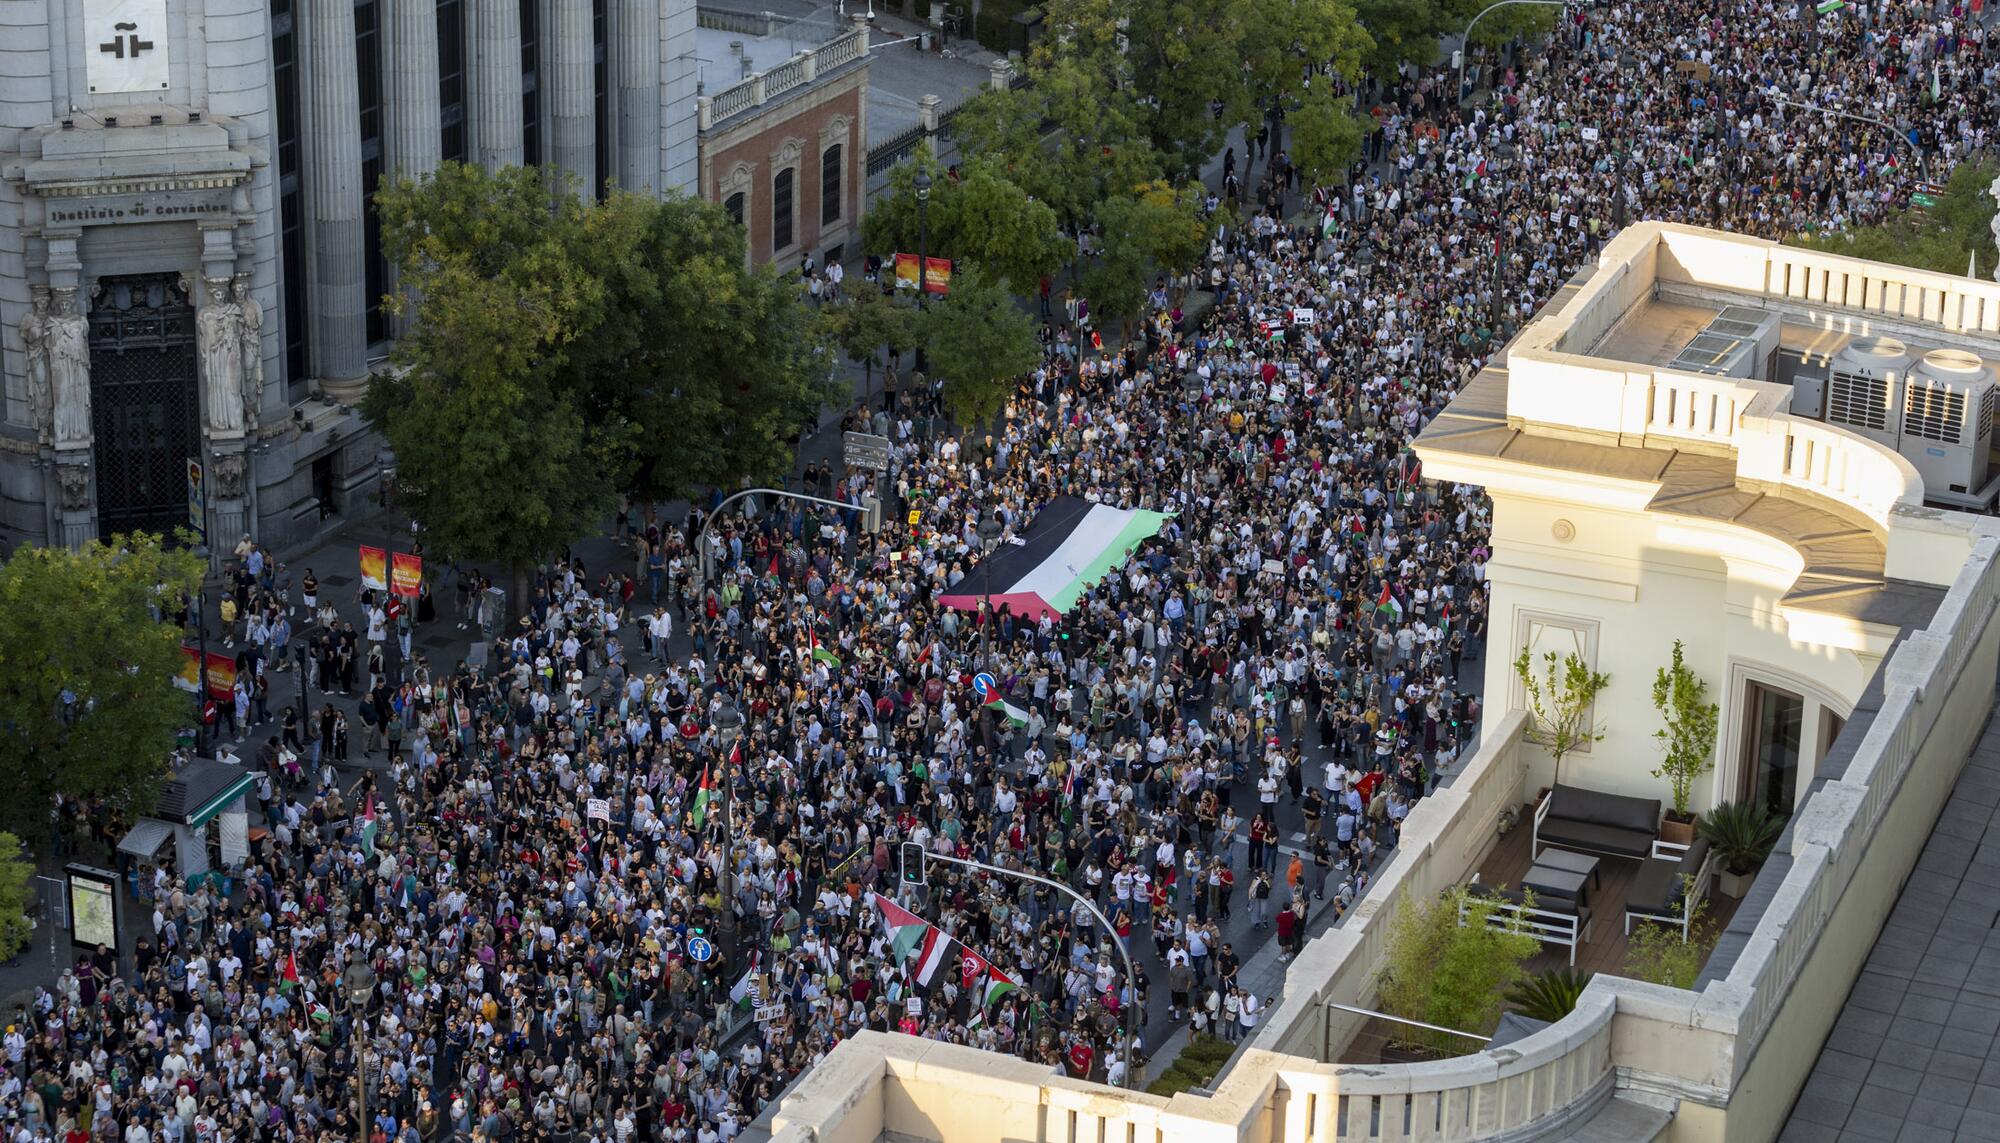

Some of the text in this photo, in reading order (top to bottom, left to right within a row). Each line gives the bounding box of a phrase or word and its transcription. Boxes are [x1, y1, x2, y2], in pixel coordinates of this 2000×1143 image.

[52, 203, 228, 222] Instituto Cervantes
[757, 1009, 768, 1020] Ni
